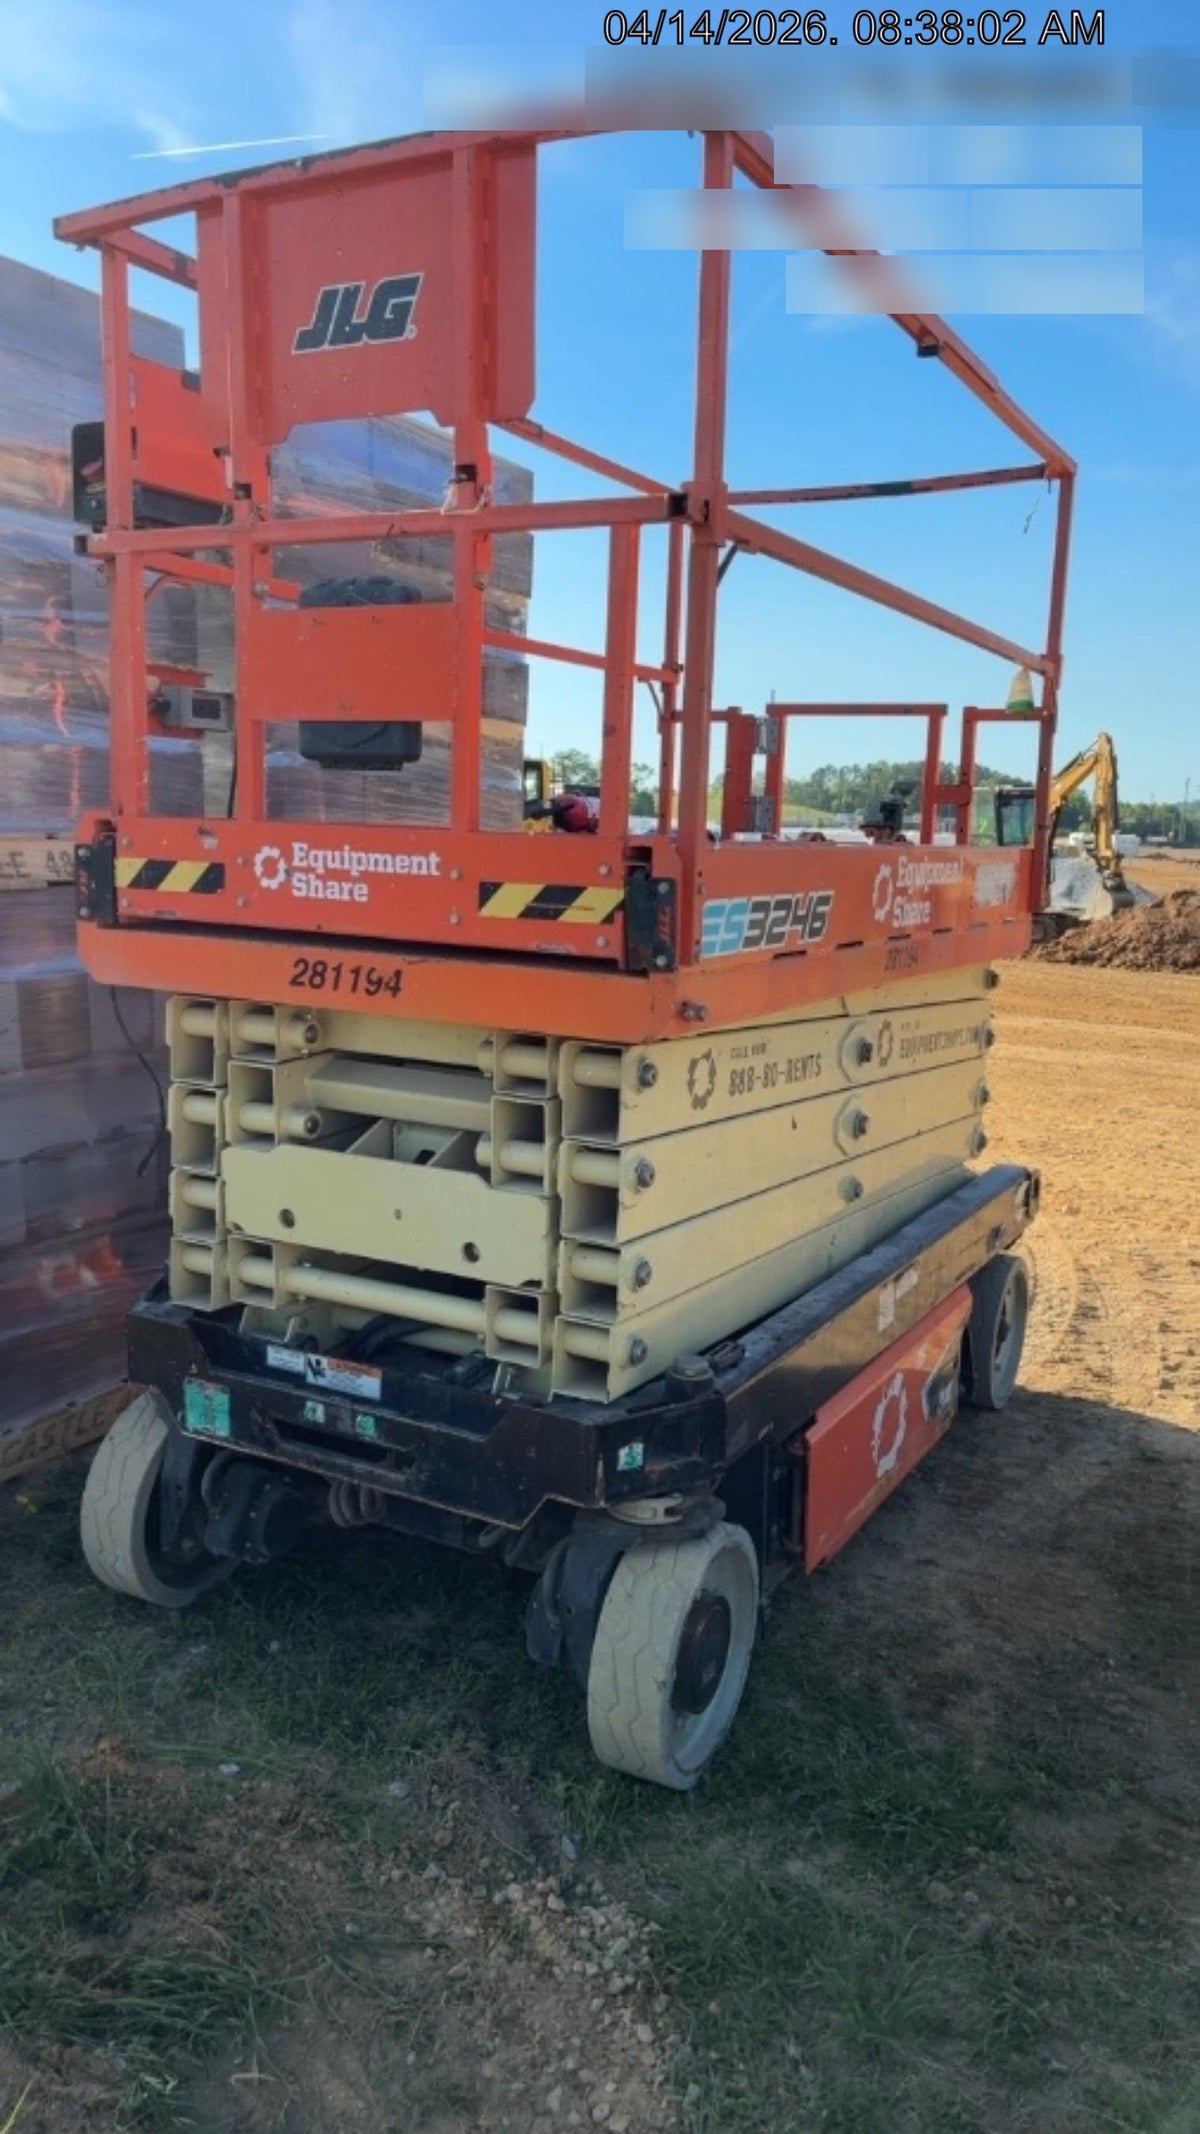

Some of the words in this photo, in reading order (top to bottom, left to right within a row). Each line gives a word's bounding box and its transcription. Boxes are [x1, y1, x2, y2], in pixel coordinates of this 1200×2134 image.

[291, 272, 425, 355] JLG
[291, 841, 442, 876] Equipment
[291, 872, 370, 902] Share
[702, 890, 835, 958] ES3246
[289, 957, 403, 999] 281194
